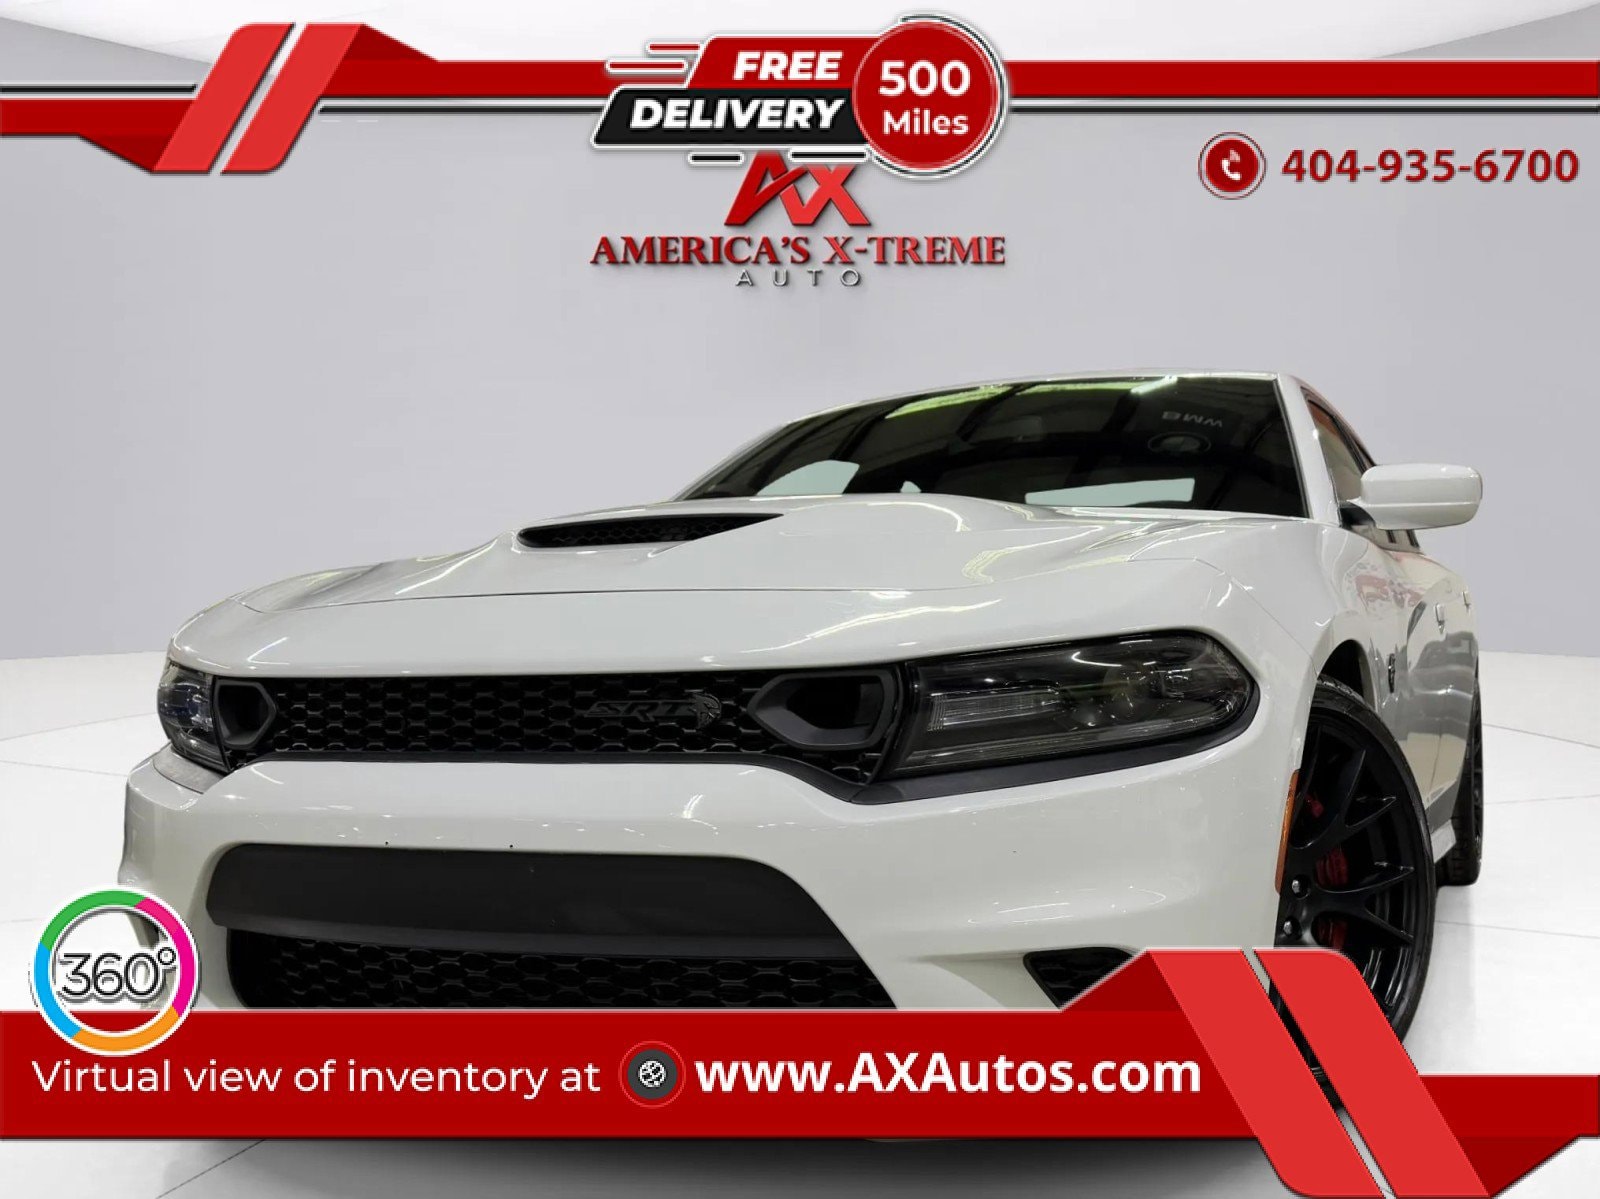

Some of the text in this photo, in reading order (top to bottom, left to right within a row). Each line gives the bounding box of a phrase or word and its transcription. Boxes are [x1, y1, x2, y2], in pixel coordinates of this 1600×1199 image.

[724, 152, 871, 226] AX
[590, 236, 1006, 265] AMERICA'S X-TREME
[735, 268, 862, 287] AUTO
[584, 701, 701, 722] SRT
